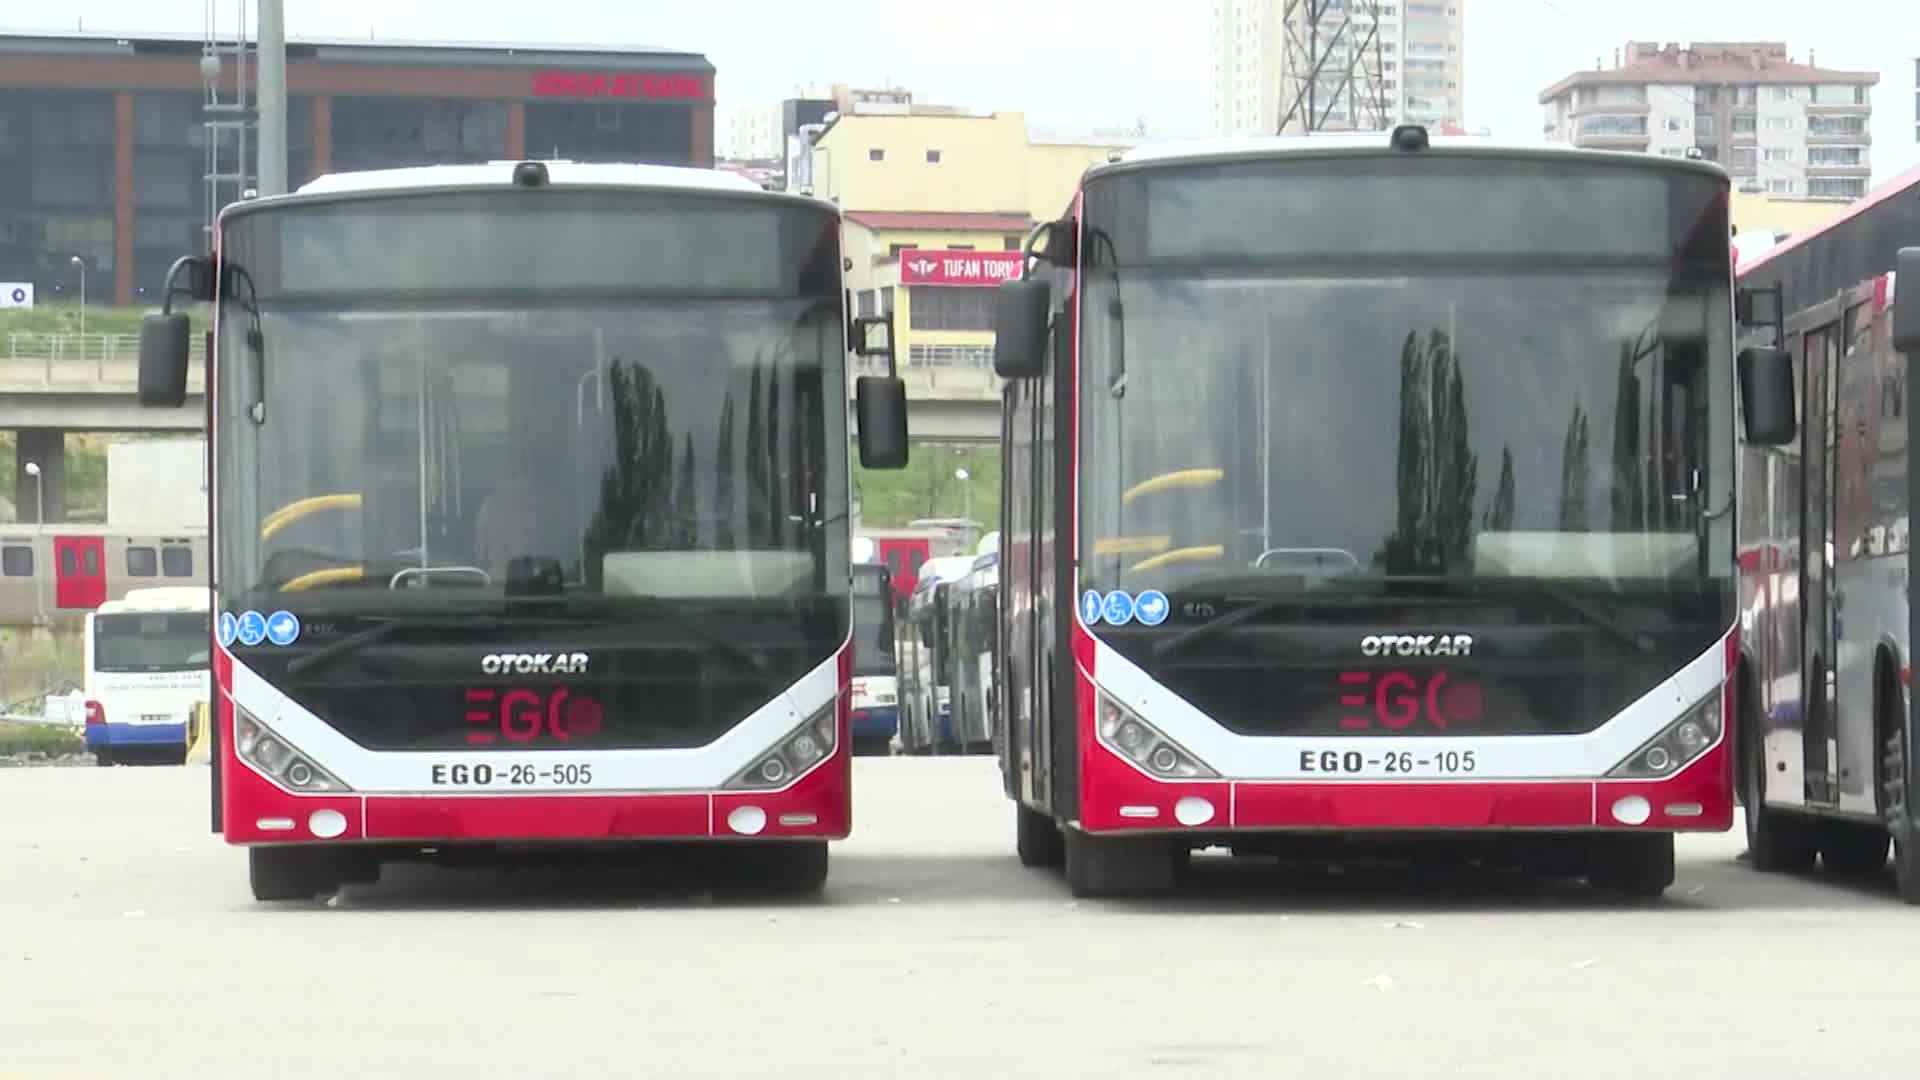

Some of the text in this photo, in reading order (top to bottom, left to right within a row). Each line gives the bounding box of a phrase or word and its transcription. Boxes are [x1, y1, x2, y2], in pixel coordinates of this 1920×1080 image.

[943, 259, 981, 278] TUFAN
[1361, 635, 1473, 656] OTOKAR
[481, 653, 589, 673] OTOKAR
[1300, 751, 1476, 773] EGO-26-105
[432, 764, 593, 785] EGO-26-505
